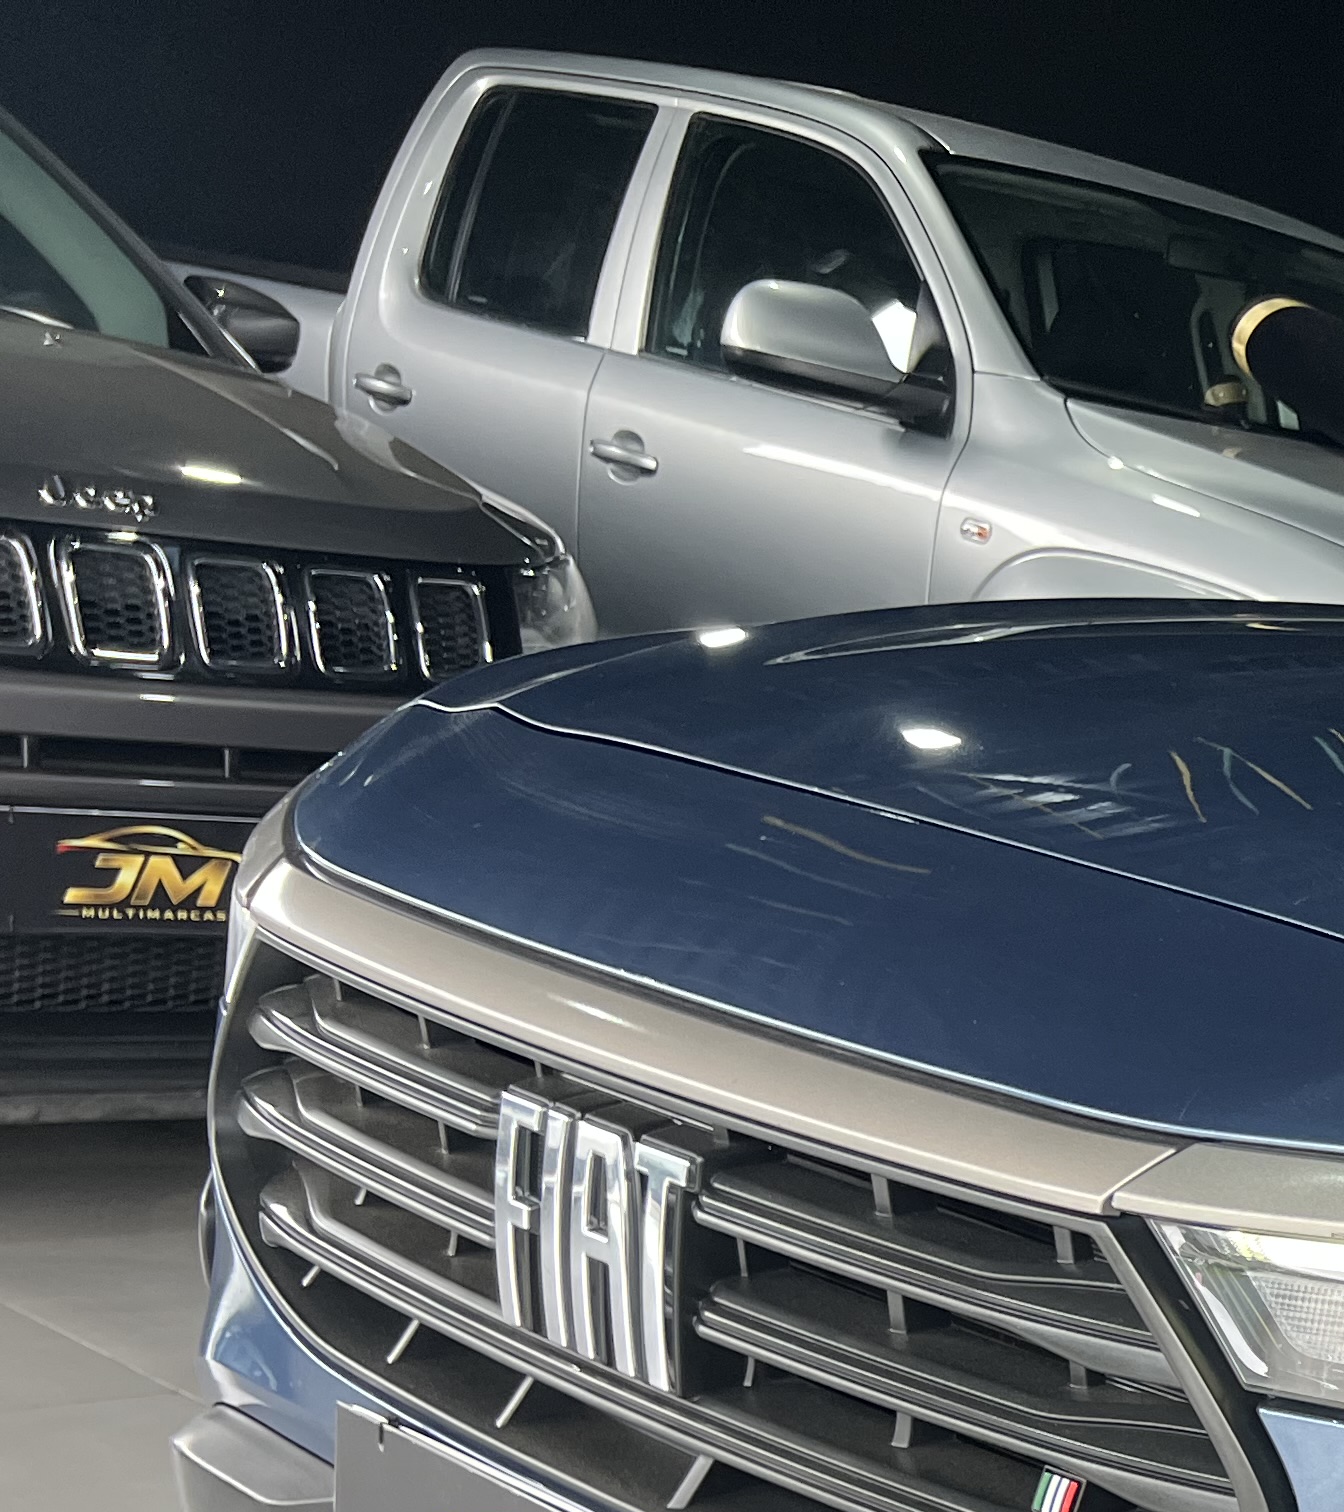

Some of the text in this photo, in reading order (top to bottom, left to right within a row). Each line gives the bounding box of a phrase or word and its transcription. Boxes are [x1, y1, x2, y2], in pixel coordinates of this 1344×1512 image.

[38, 474, 156, 523] Jeep
[63, 852, 233, 908] JM
[81, 906, 228, 923] MULTIMARCAS
[495, 1090, 692, 1393] FIAT
